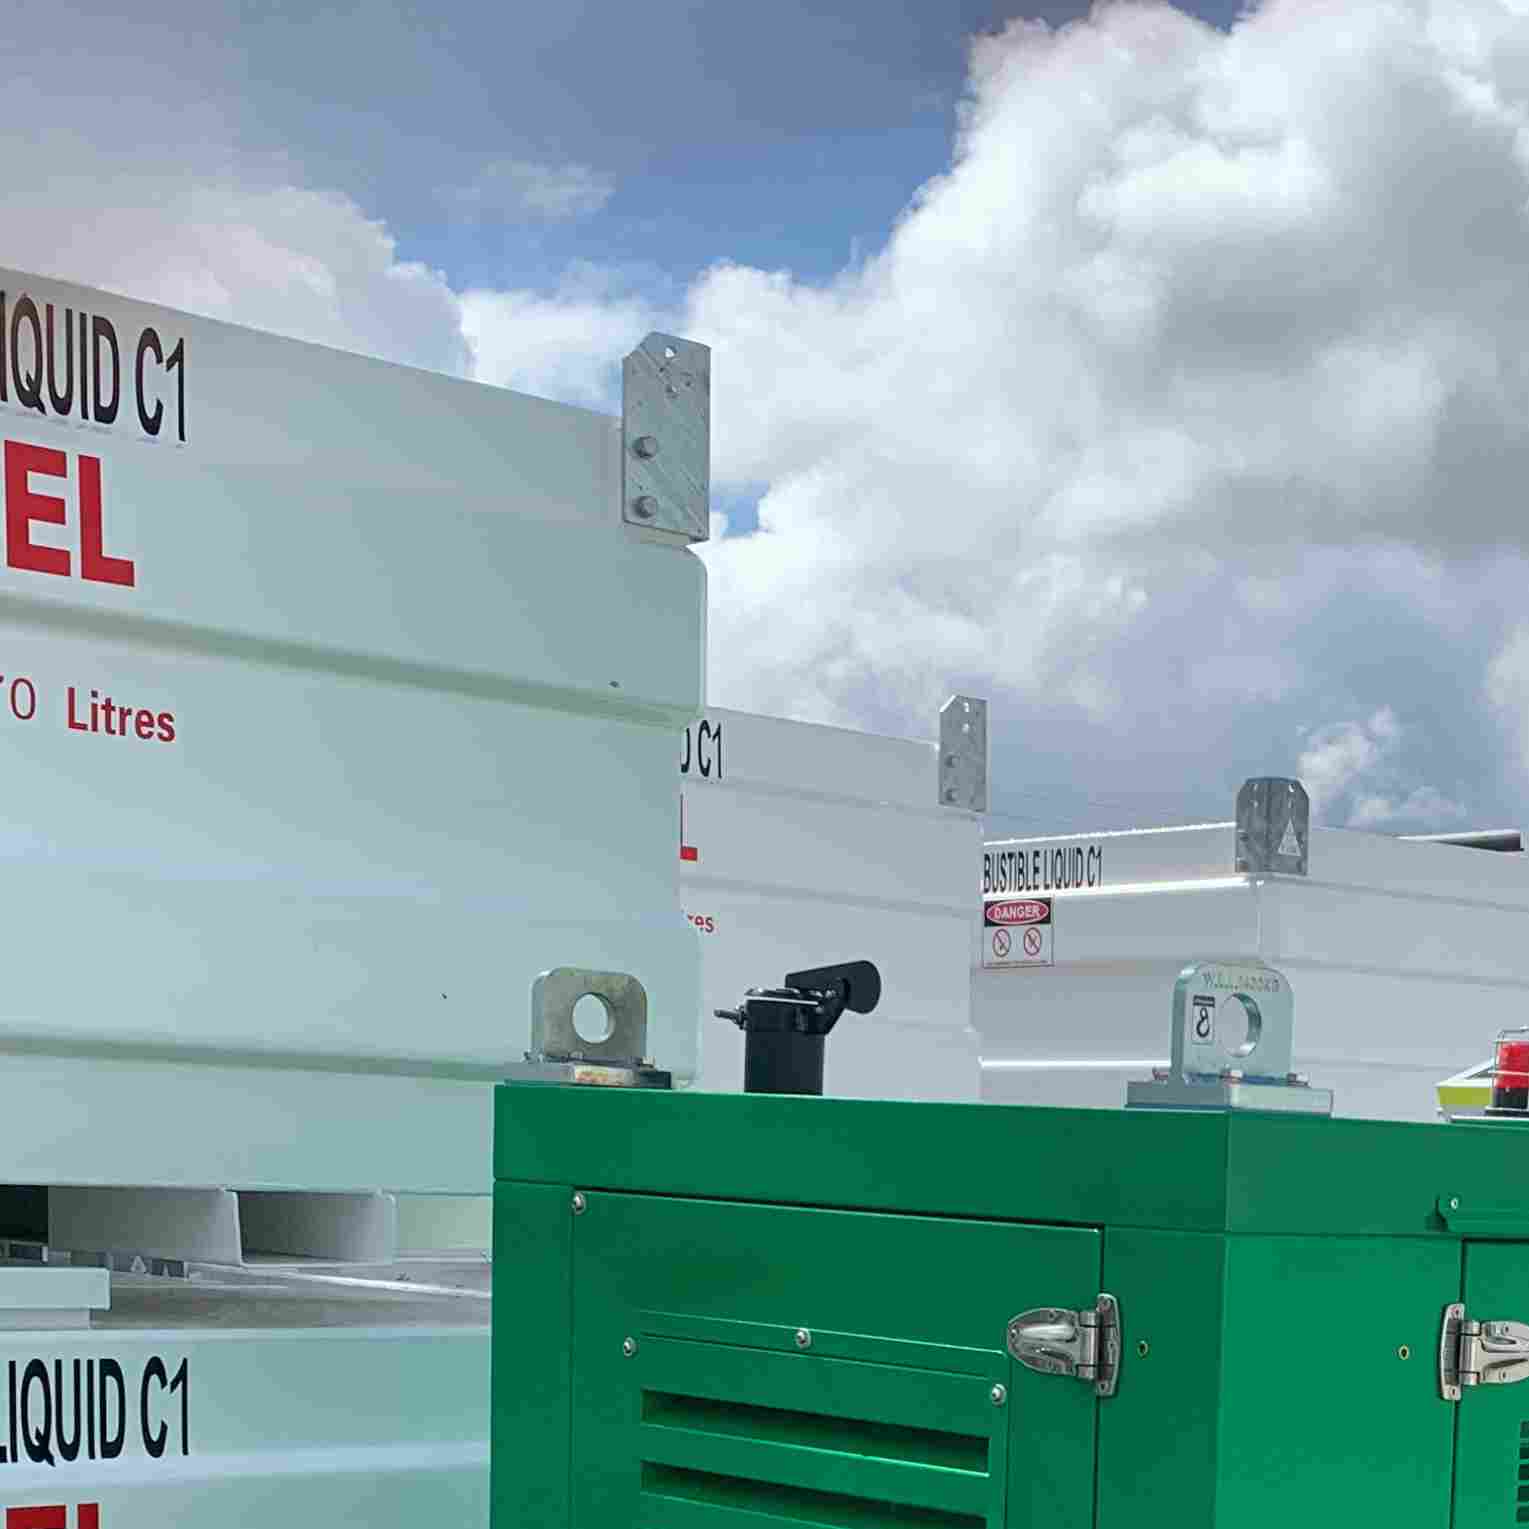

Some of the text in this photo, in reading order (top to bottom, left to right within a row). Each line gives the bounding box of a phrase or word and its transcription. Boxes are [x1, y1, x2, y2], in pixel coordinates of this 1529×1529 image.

[136, 328, 186, 442] C1
[4, 440, 135, 587] EL
[67, 687, 176, 743] Litres
[698, 719, 722, 778] C1
[984, 845, 1103, 893] BUSTIBLE LIQUID C1
[993, 905, 1041, 921] DANGER
[141, 1356, 189, 1459] C1
